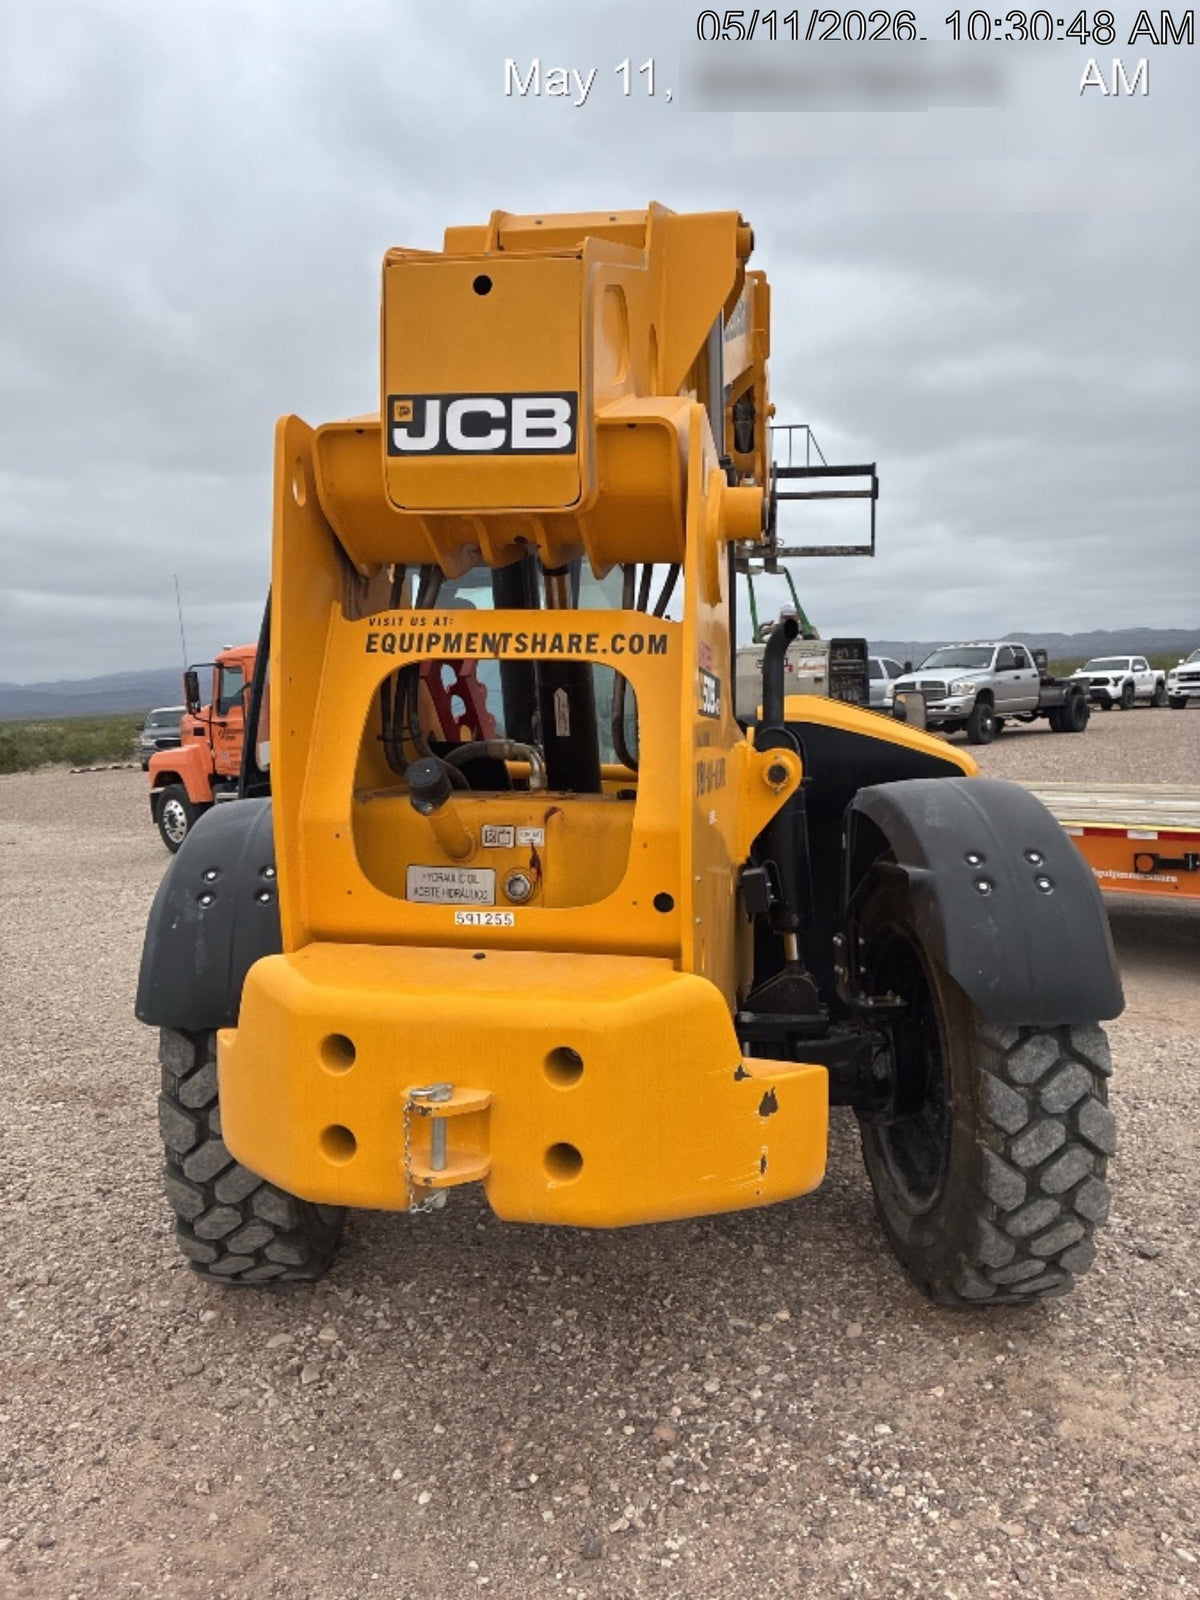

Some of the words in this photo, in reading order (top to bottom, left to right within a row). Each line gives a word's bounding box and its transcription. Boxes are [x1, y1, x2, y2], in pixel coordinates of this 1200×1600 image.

[393, 398, 572, 450] JCB
[369, 616, 404, 626] VISIT
[410, 617, 427, 626] US
[433, 617, 454, 626] AT:
[365, 632, 668, 655] EQUIPMENTSHARE.COM
[456, 913, 513, 926] 591255
